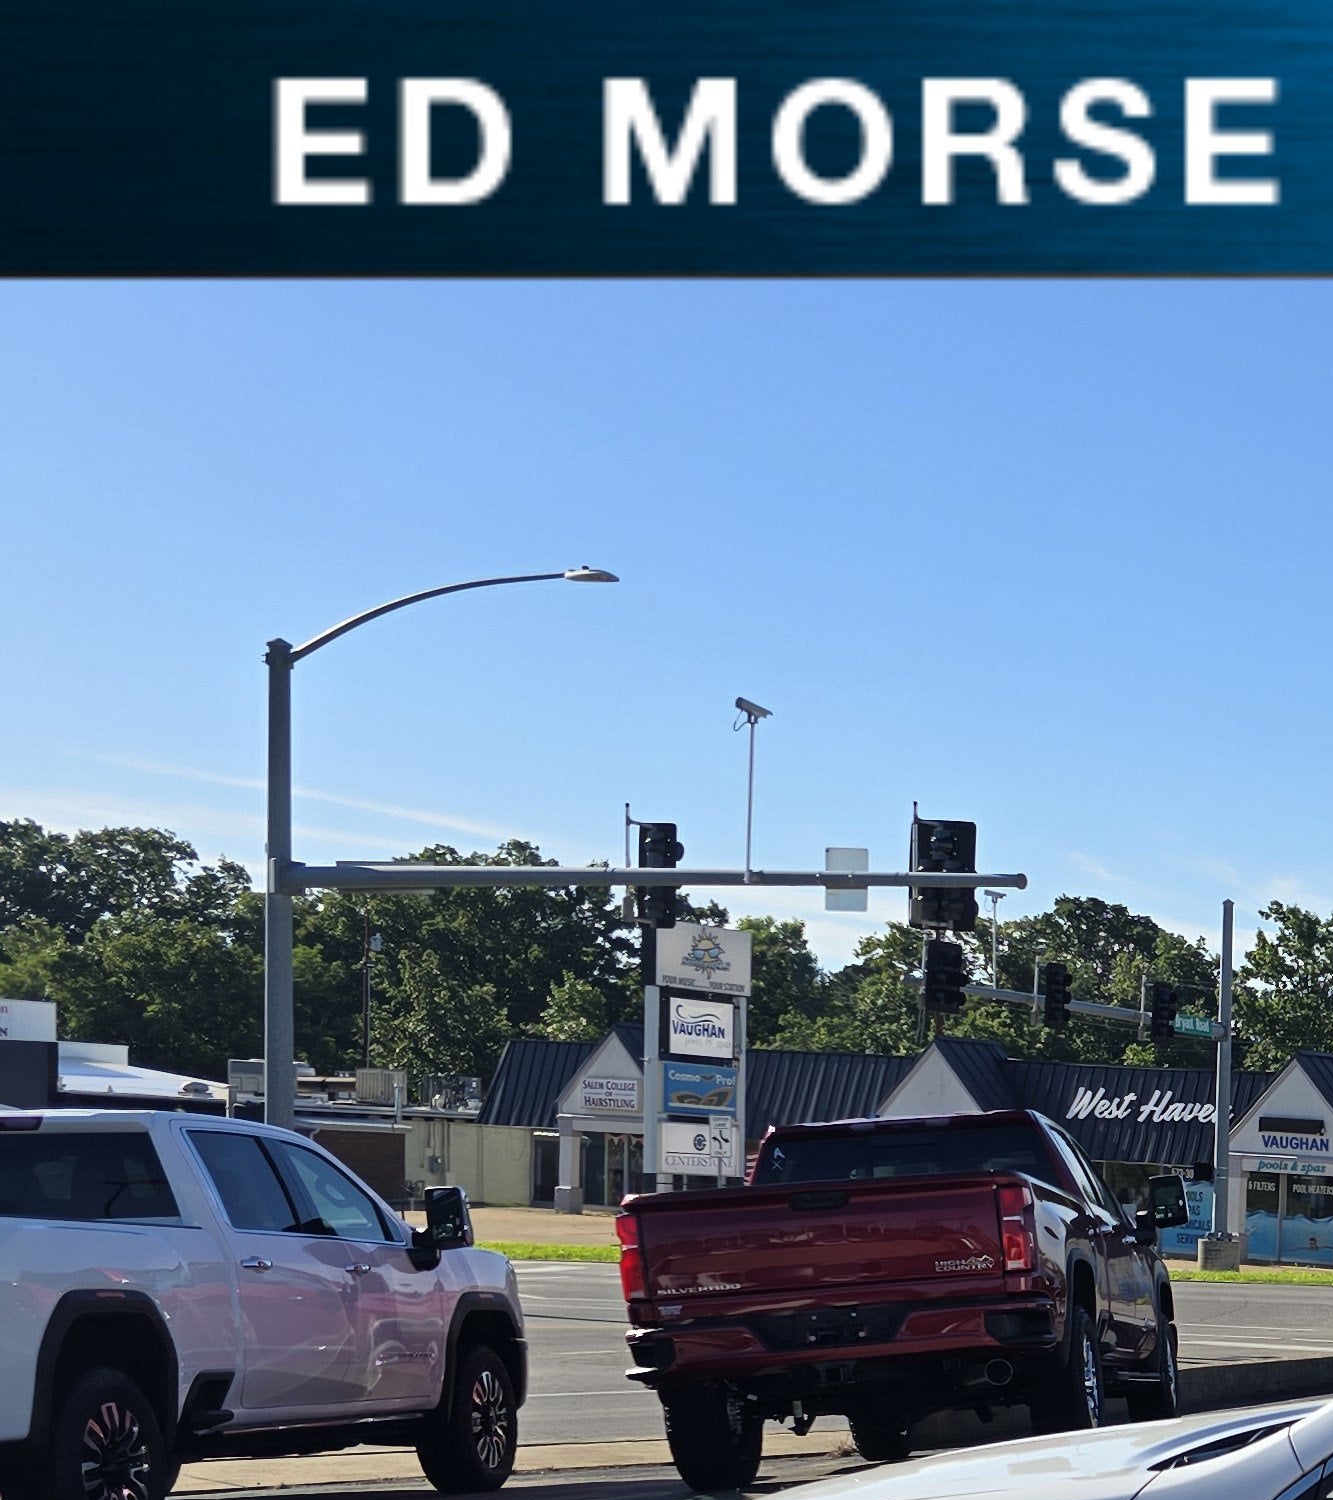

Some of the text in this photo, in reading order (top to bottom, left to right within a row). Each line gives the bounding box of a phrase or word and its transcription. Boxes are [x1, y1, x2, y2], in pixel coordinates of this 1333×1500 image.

[672, 1020, 725, 1039] VAUGHAN
[582, 1079, 636, 1092] SALEM COLLEGE
[584, 1095, 635, 1109] HAIRSTYLING
[1065, 1086, 1138, 1120] West
[1261, 1134, 1330, 1152] VAUGHAN
[1257, 1160, 1289, 1172] pools
[1301, 1163, 1327, 1176] spas
[1253, 1181, 1276, 1192] FILTERS
[1292, 1183, 1309, 1194] POOL
